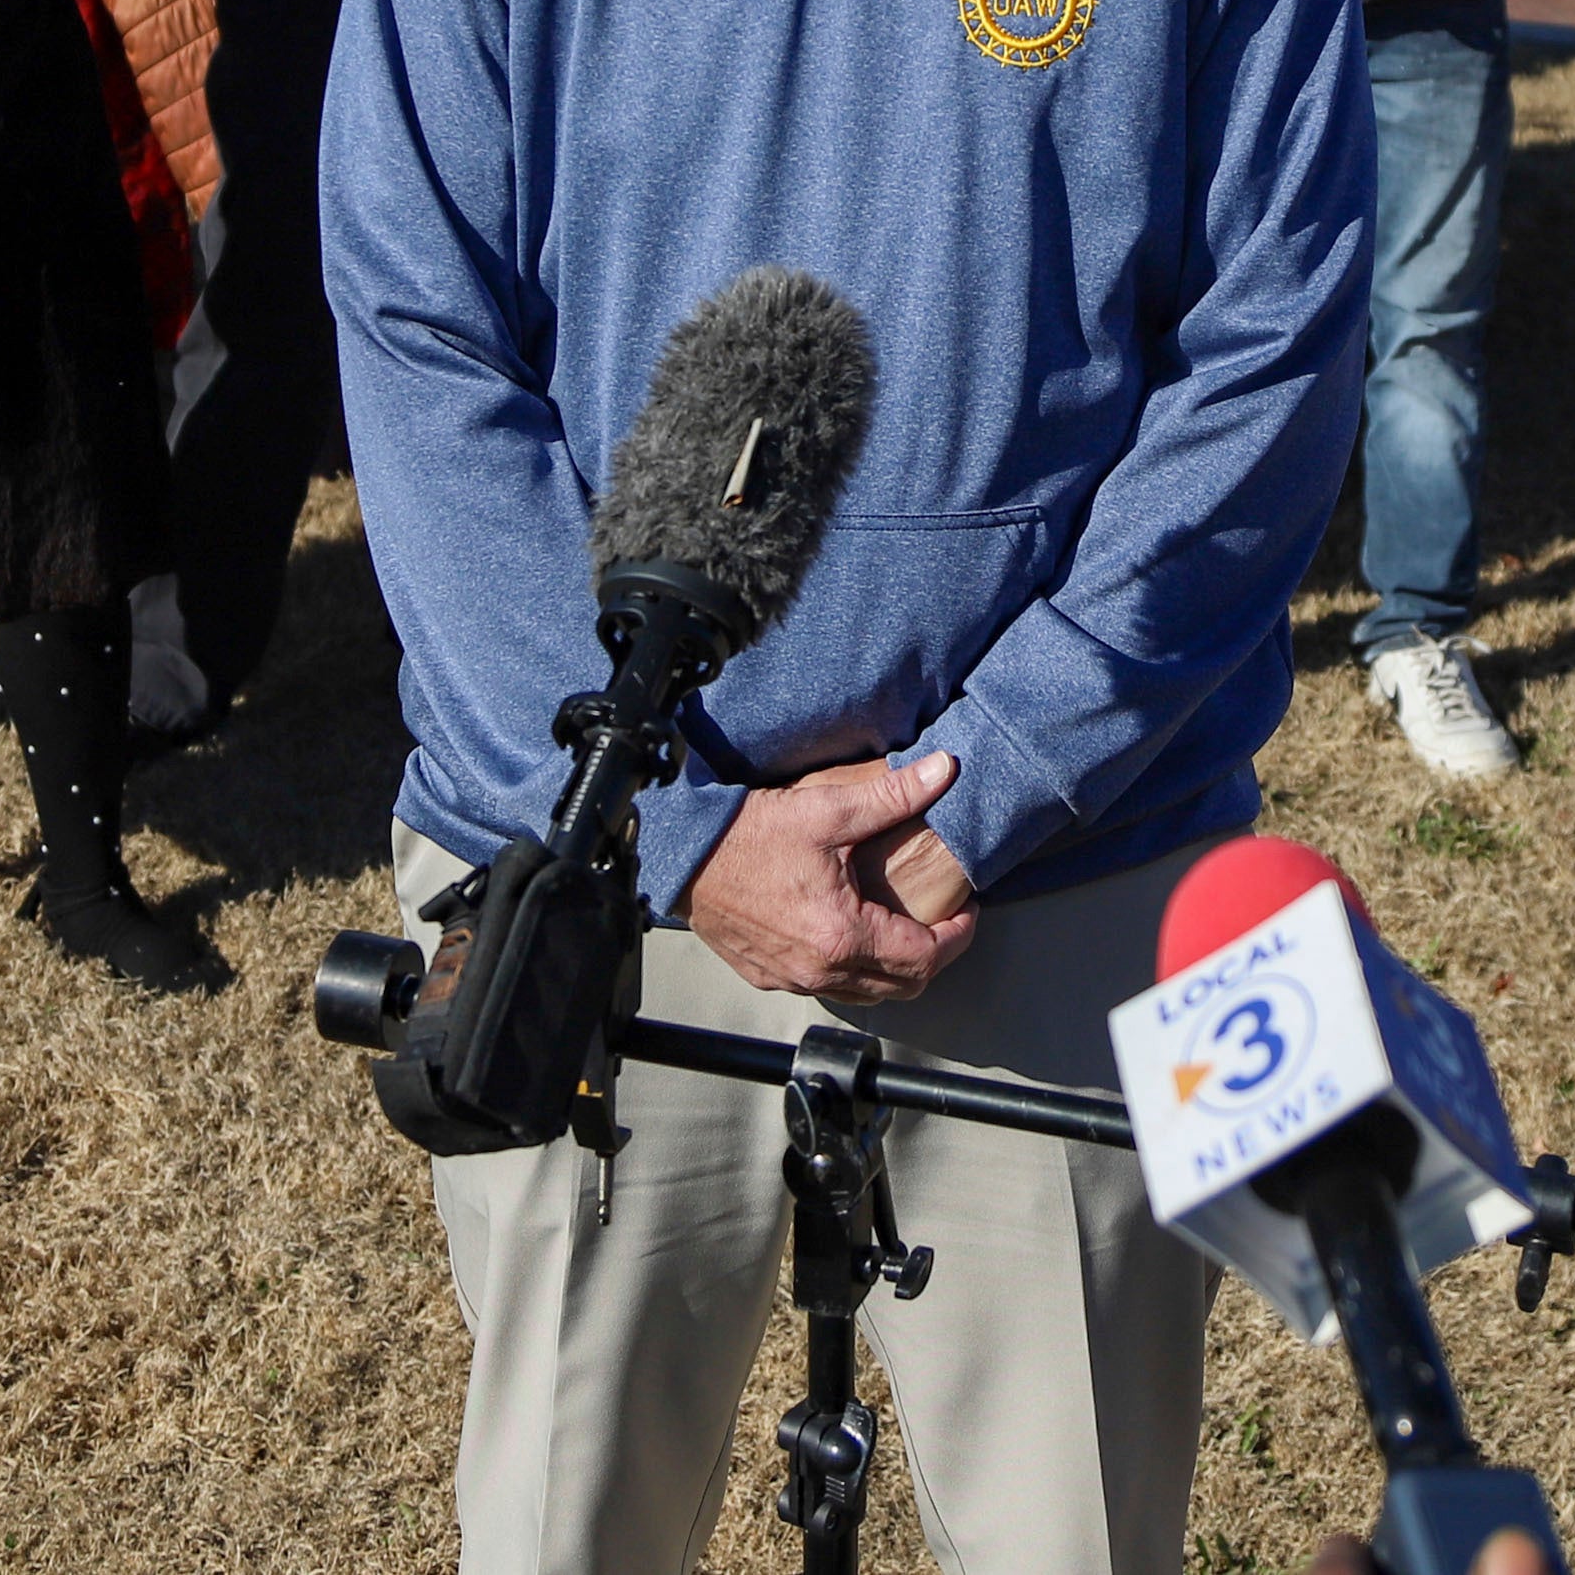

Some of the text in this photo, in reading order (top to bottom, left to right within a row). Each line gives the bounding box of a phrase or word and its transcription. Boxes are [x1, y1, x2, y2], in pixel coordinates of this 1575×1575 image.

[1155, 929, 1298, 1025] LOCAL
[1212, 997, 1285, 1092] 3
[1193, 1074, 1343, 1183] NEWS
